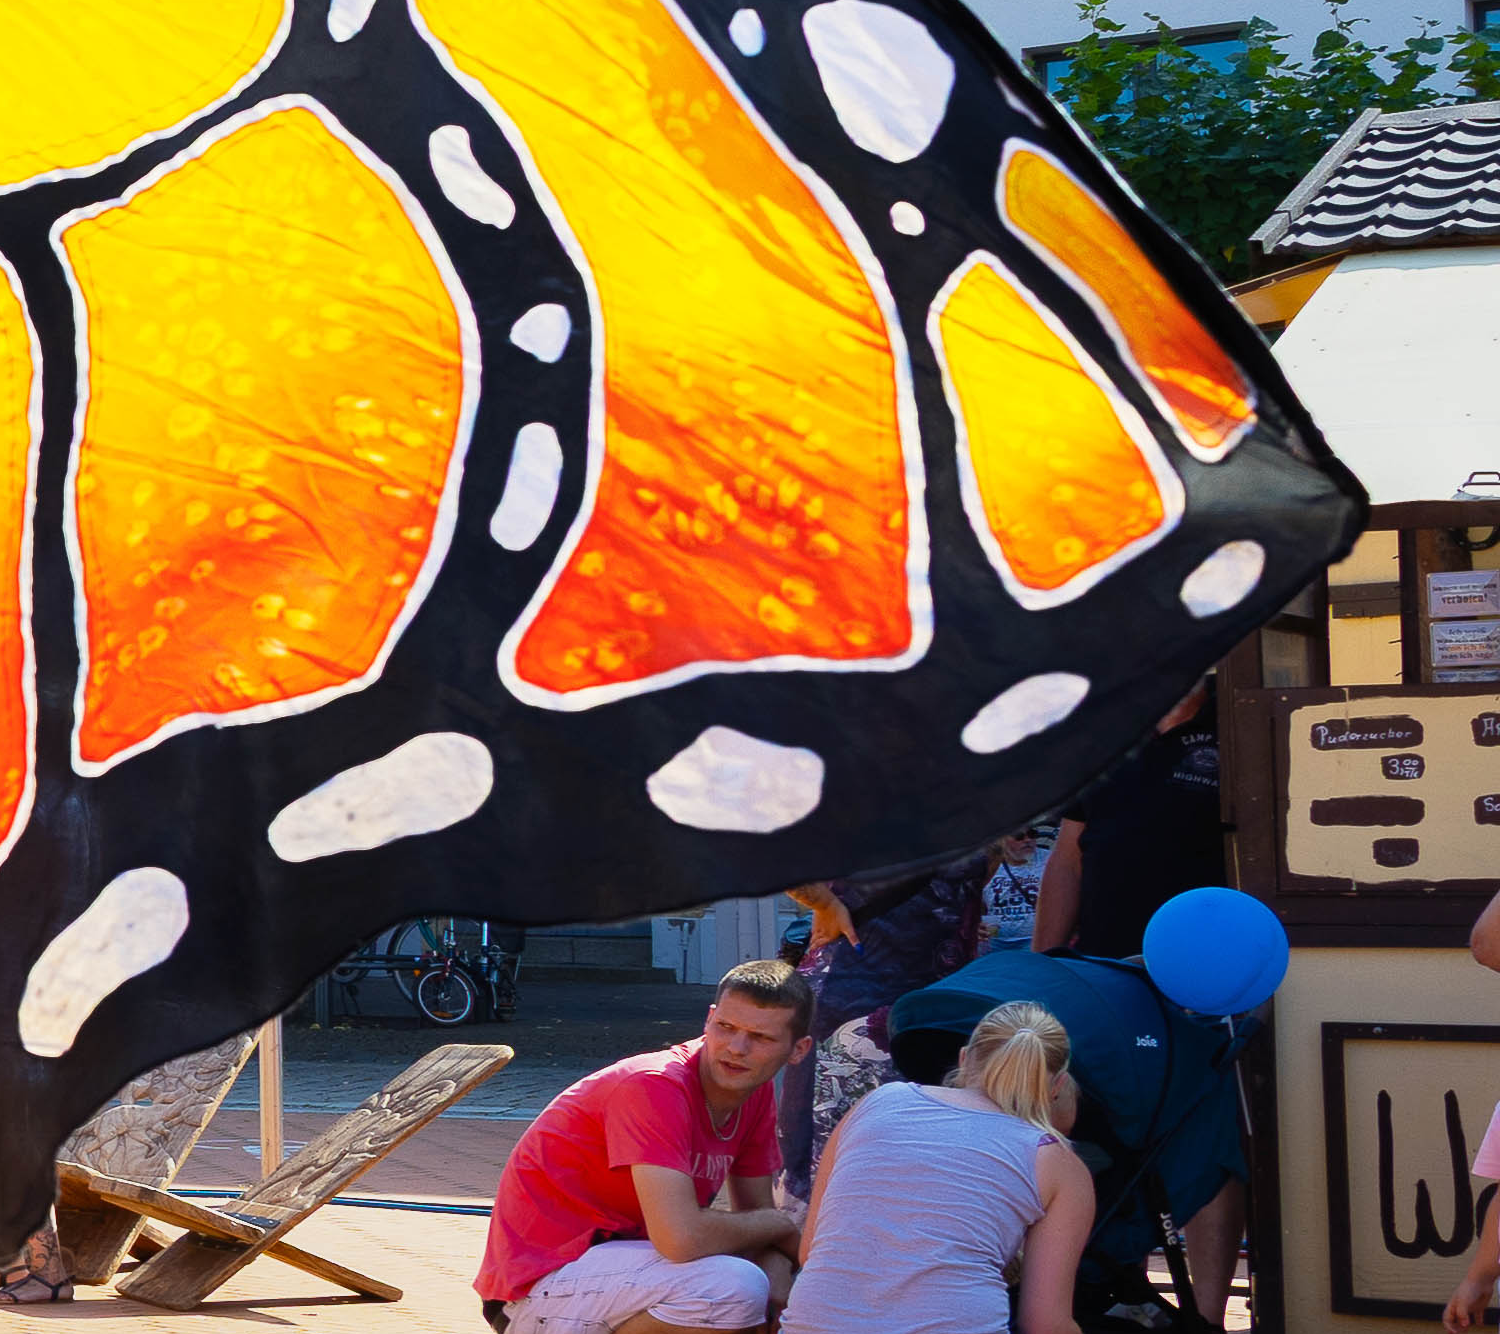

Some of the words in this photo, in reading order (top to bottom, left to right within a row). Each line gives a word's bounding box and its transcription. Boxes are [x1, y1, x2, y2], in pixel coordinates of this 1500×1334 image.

[1173, 772, 1220, 787] HIGHWA
[1136, 1034, 1158, 1047] Joie
[1160, 1212, 1178, 1246] Joie
